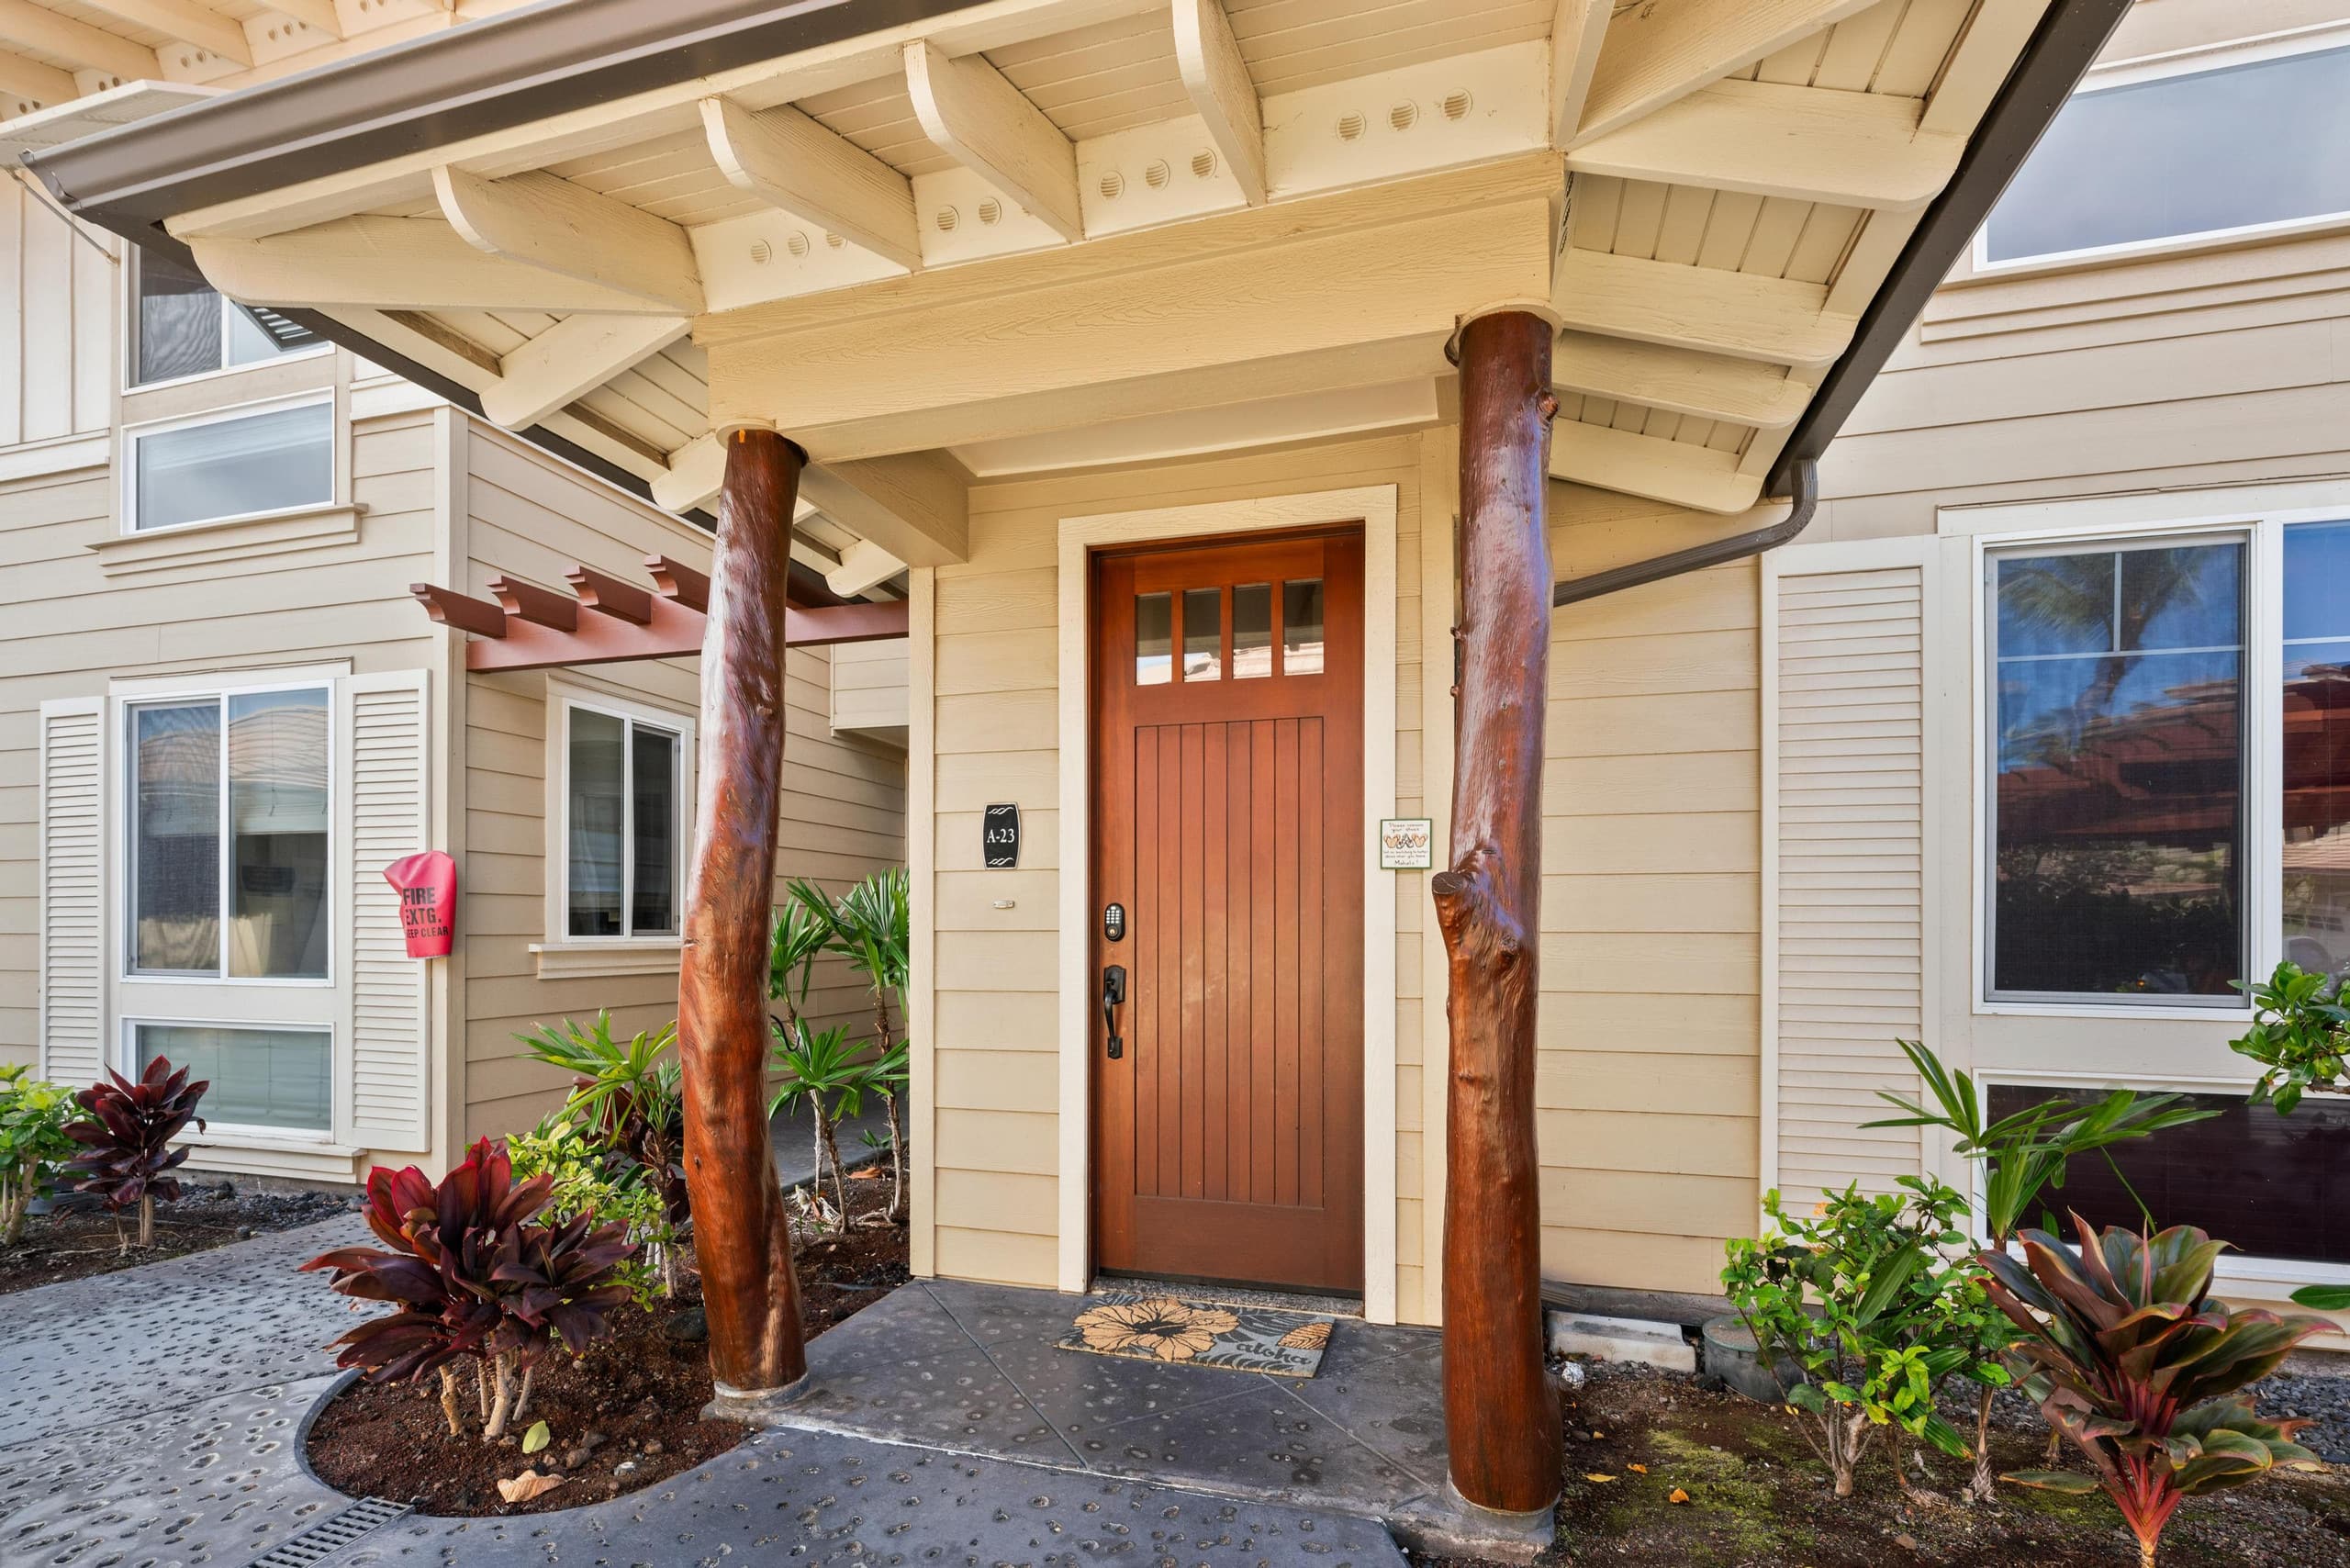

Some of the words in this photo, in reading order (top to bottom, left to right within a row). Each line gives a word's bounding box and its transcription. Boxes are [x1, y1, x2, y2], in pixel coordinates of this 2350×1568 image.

[987, 828, 1015, 843] A-23
[403, 887, 436, 906] FIRE
[407, 928, 419, 938] EEP
[421, 926, 449, 937] CLEAR
[1237, 1342, 1312, 1365] aloha
